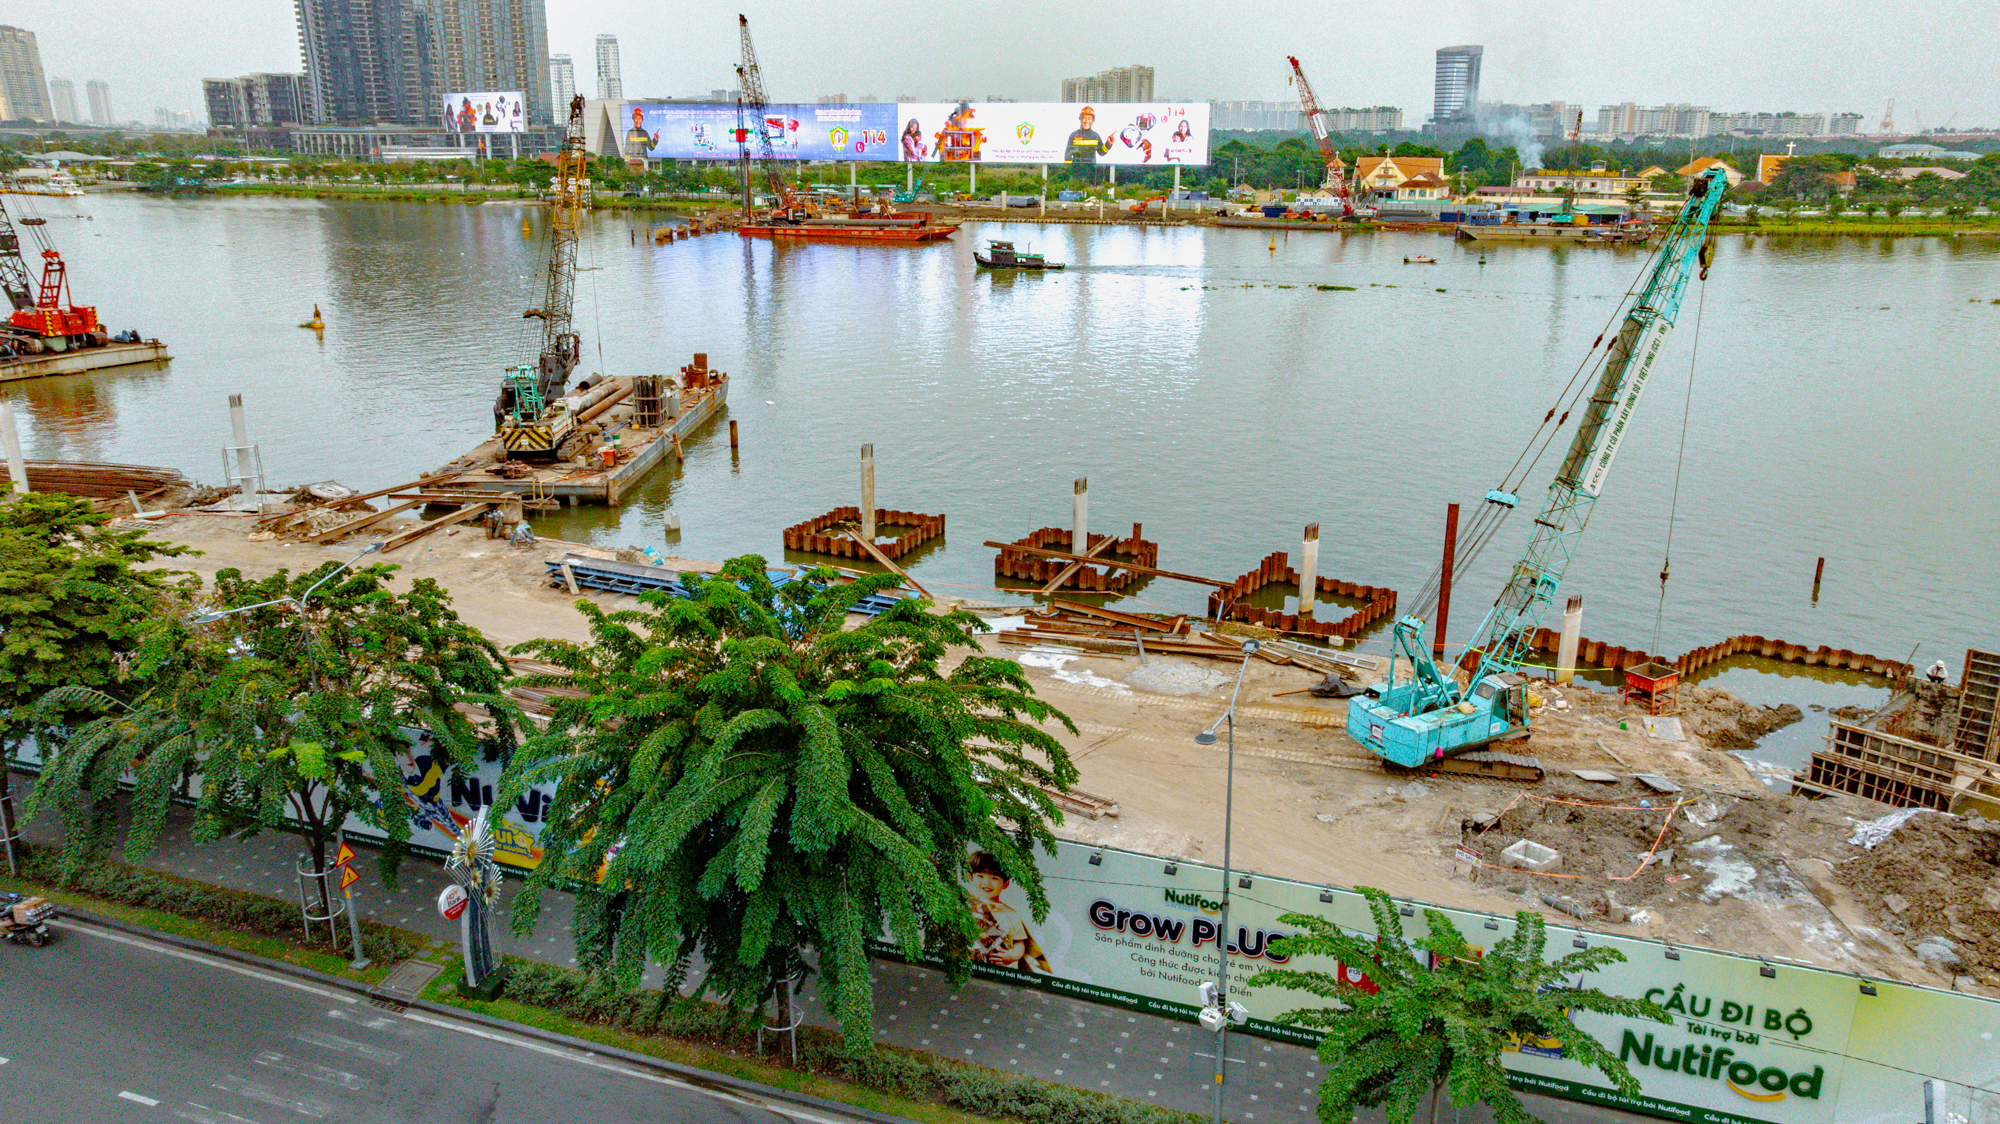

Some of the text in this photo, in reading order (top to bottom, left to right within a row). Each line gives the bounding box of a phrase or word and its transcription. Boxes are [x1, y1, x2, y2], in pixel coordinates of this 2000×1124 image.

[1168, 106, 1185, 116] 114
[862, 130, 886, 144] 114
[1600, 452, 1611, 468] CÔNG
[1606, 444, 1614, 454] TY
[1620, 408, 1630, 422] XÂY
[1089, 899, 1185, 943] Grow
[1094, 932, 1112, 944] Sản
[1116, 937, 1142, 949] phẩm
[1145, 942, 1165, 954] dinh
[1168, 947, 1199, 962] dưỡng
[1202, 954, 1220, 964] cho
[1130, 952, 1156, 966] Công
[1159, 958, 1179, 969] thức
[1182, 962, 1205, 975] được
[1017, 974, 1042, 984] Nutifood
[1140, 967, 1156, 978] bởi
[1159, 971, 1201, 986] Nutifood
[1230, 986, 1252, 997] Điển
[1072, 984, 1080, 992] bộ
[1112, 994, 1138, 1004] Nutifood
[1644, 982, 1812, 1040] CẦU ĐI BỘ
[1272, 1026, 1280, 1034] bộ
[1686, 1022, 1760, 1046] Tài trợ bởi
[1620, 1028, 1824, 1100] Nutifood
[1538, 1080, 1569, 1091] Nutifood
[1582, 1088, 1597, 1096] Cầu
[1607, 1093, 1618, 1102] bộ
[1643, 1100, 1656, 1108] bởi
[1658, 1104, 1691, 1116] Nutifood
[1704, 1113, 1720, 1122] Cầu
